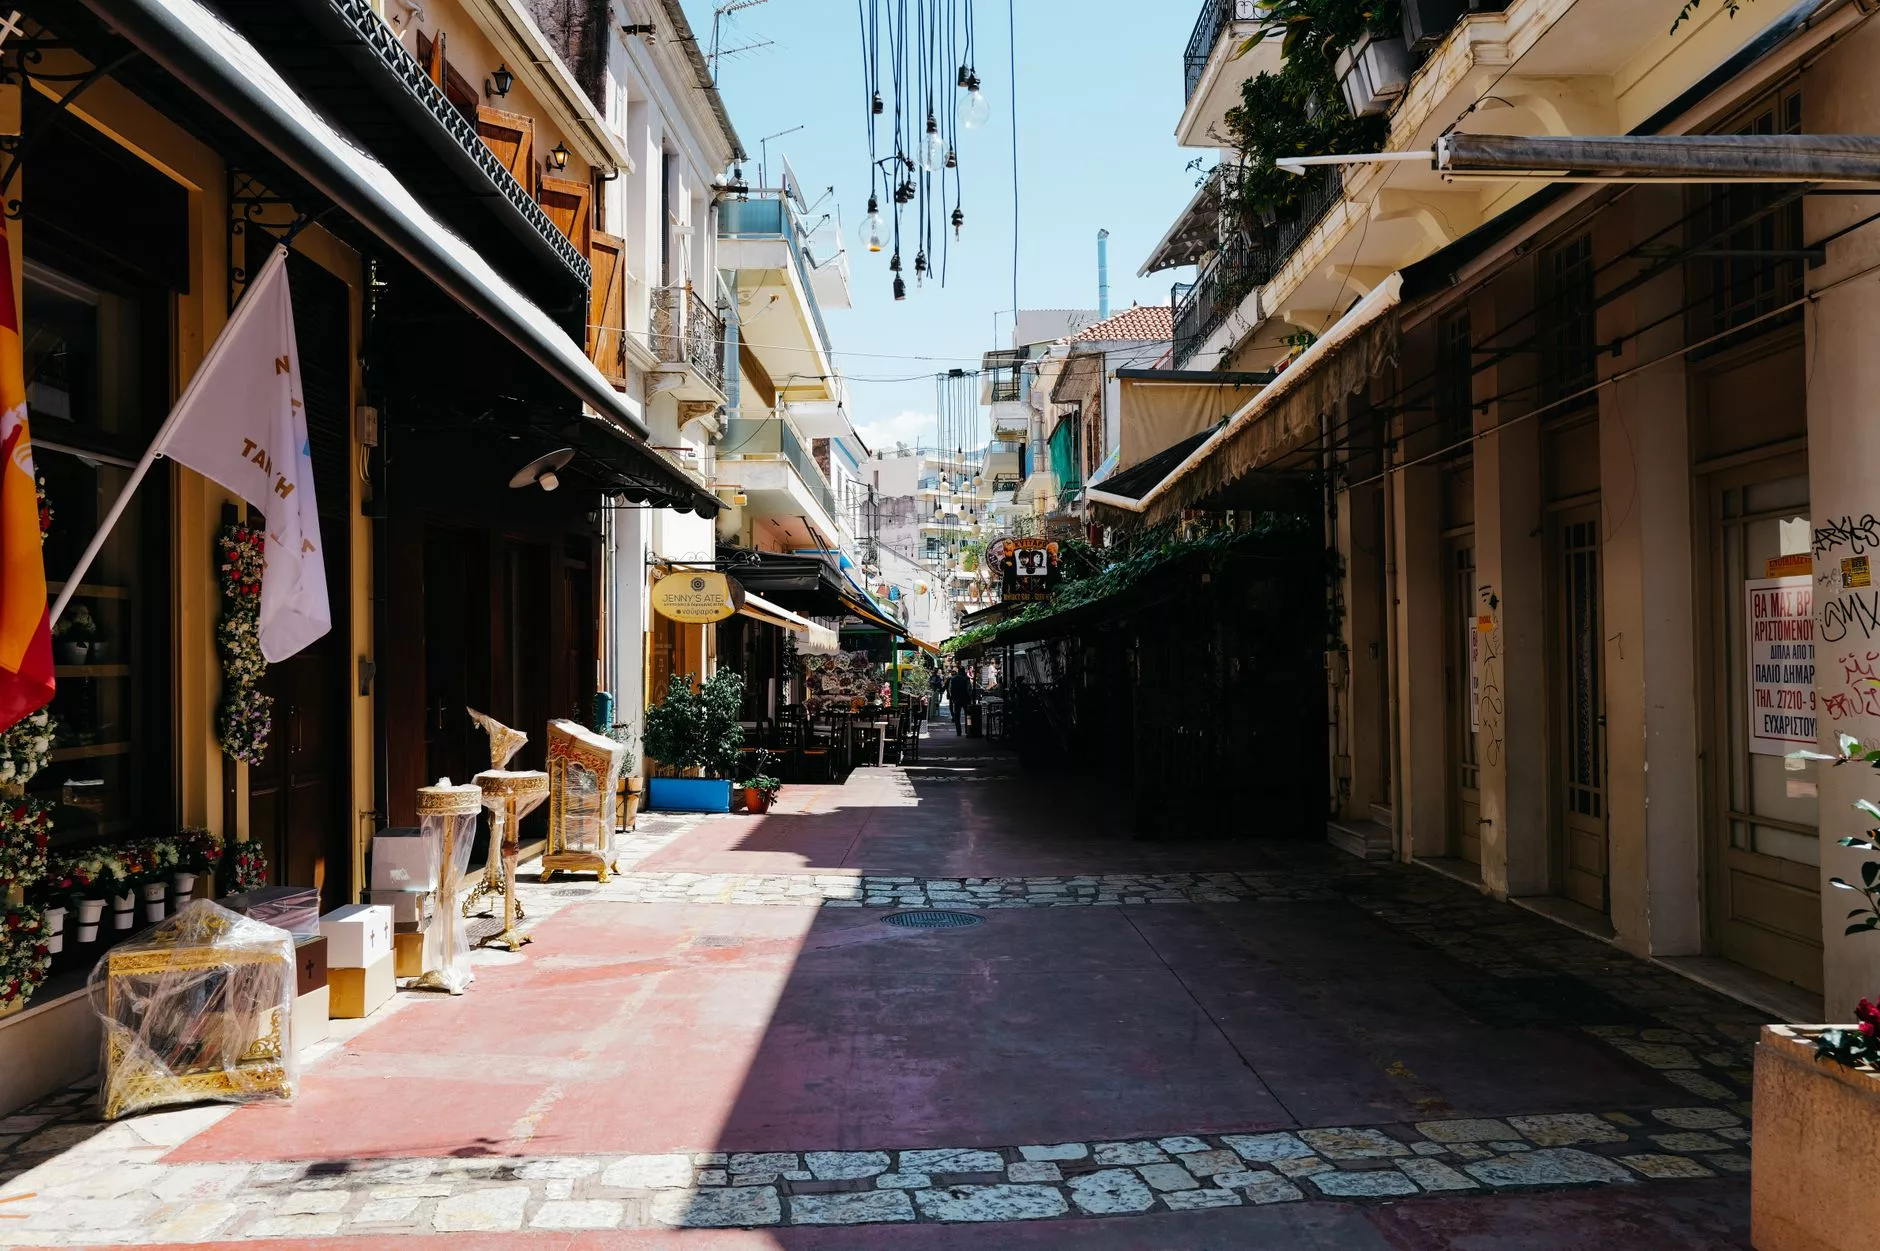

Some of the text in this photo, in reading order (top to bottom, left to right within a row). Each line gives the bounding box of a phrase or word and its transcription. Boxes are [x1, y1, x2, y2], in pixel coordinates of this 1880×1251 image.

[662, 594, 724, 603] JENNY'S ATE
[1754, 591, 1814, 618] ΘΑ ΜΑΣ ΒΡ
[1770, 645, 1815, 659] ΔΙΠΛΑ ΑΠΟ Τ
[1755, 664, 1780, 683] ΠΑΛΙΟ
[1756, 689, 1774, 708] ΤΗΛ.
[1764, 714, 1817, 737] ΕΥΧΑΡΙΣΤΟΥ
